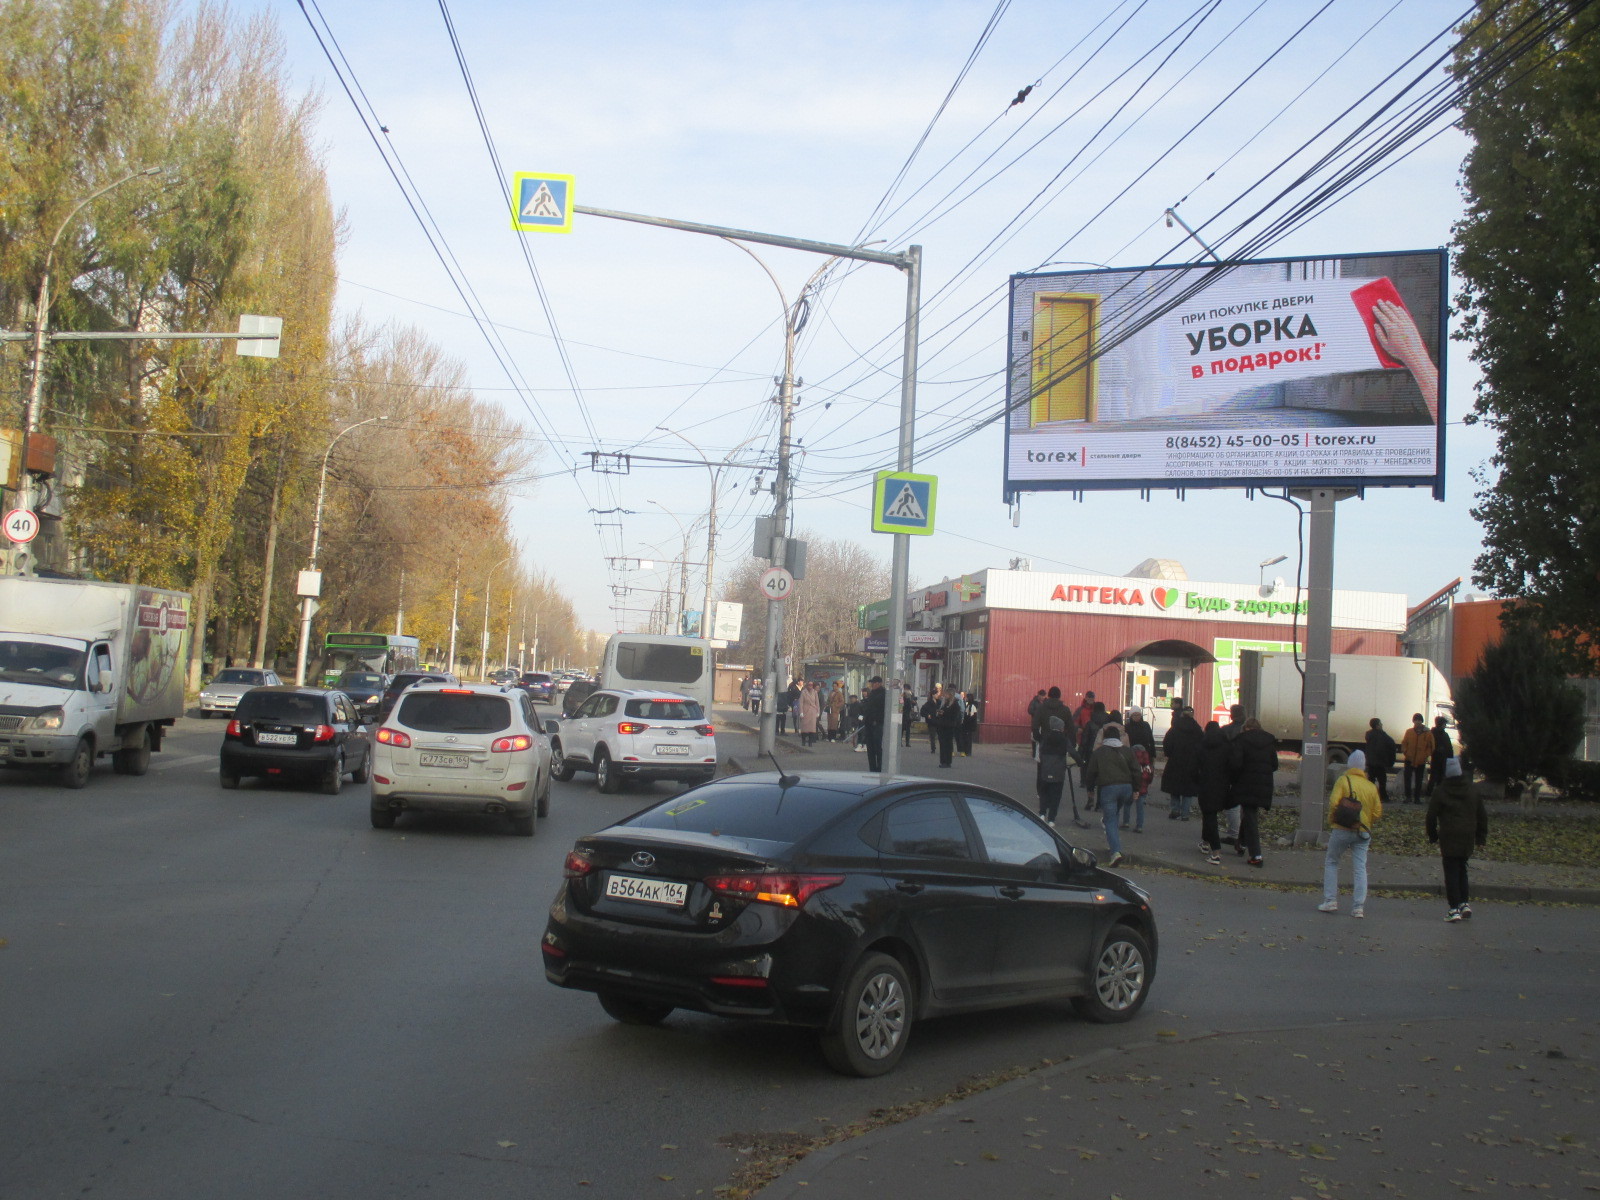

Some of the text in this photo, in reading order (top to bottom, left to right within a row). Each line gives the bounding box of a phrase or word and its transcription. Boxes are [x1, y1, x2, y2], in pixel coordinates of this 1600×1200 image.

[1181, 295, 1314, 325] ПРИ ПОКУПКЕ ДВЕРИ
[1185, 313, 1319, 356] УБОРКА
[1191, 364, 1204, 379] в
[1165, 434, 1300, 449] 8(8452) 45-00-05
[1314, 434, 1376, 446] torex.ru
[1027, 449, 1077, 463] torex
[1226, 450, 1273, 458] ОРГАНИЗАТОРЕ
[1306, 449, 1331, 457] СРОКАХ
[12, 519, 30, 532] 40
[767, 577, 787, 591] 40
[1050, 584, 1145, 606] АПТЕКА
[1186, 591, 1231, 613] Будь
[610, 878, 684, 900] В564АК 164
